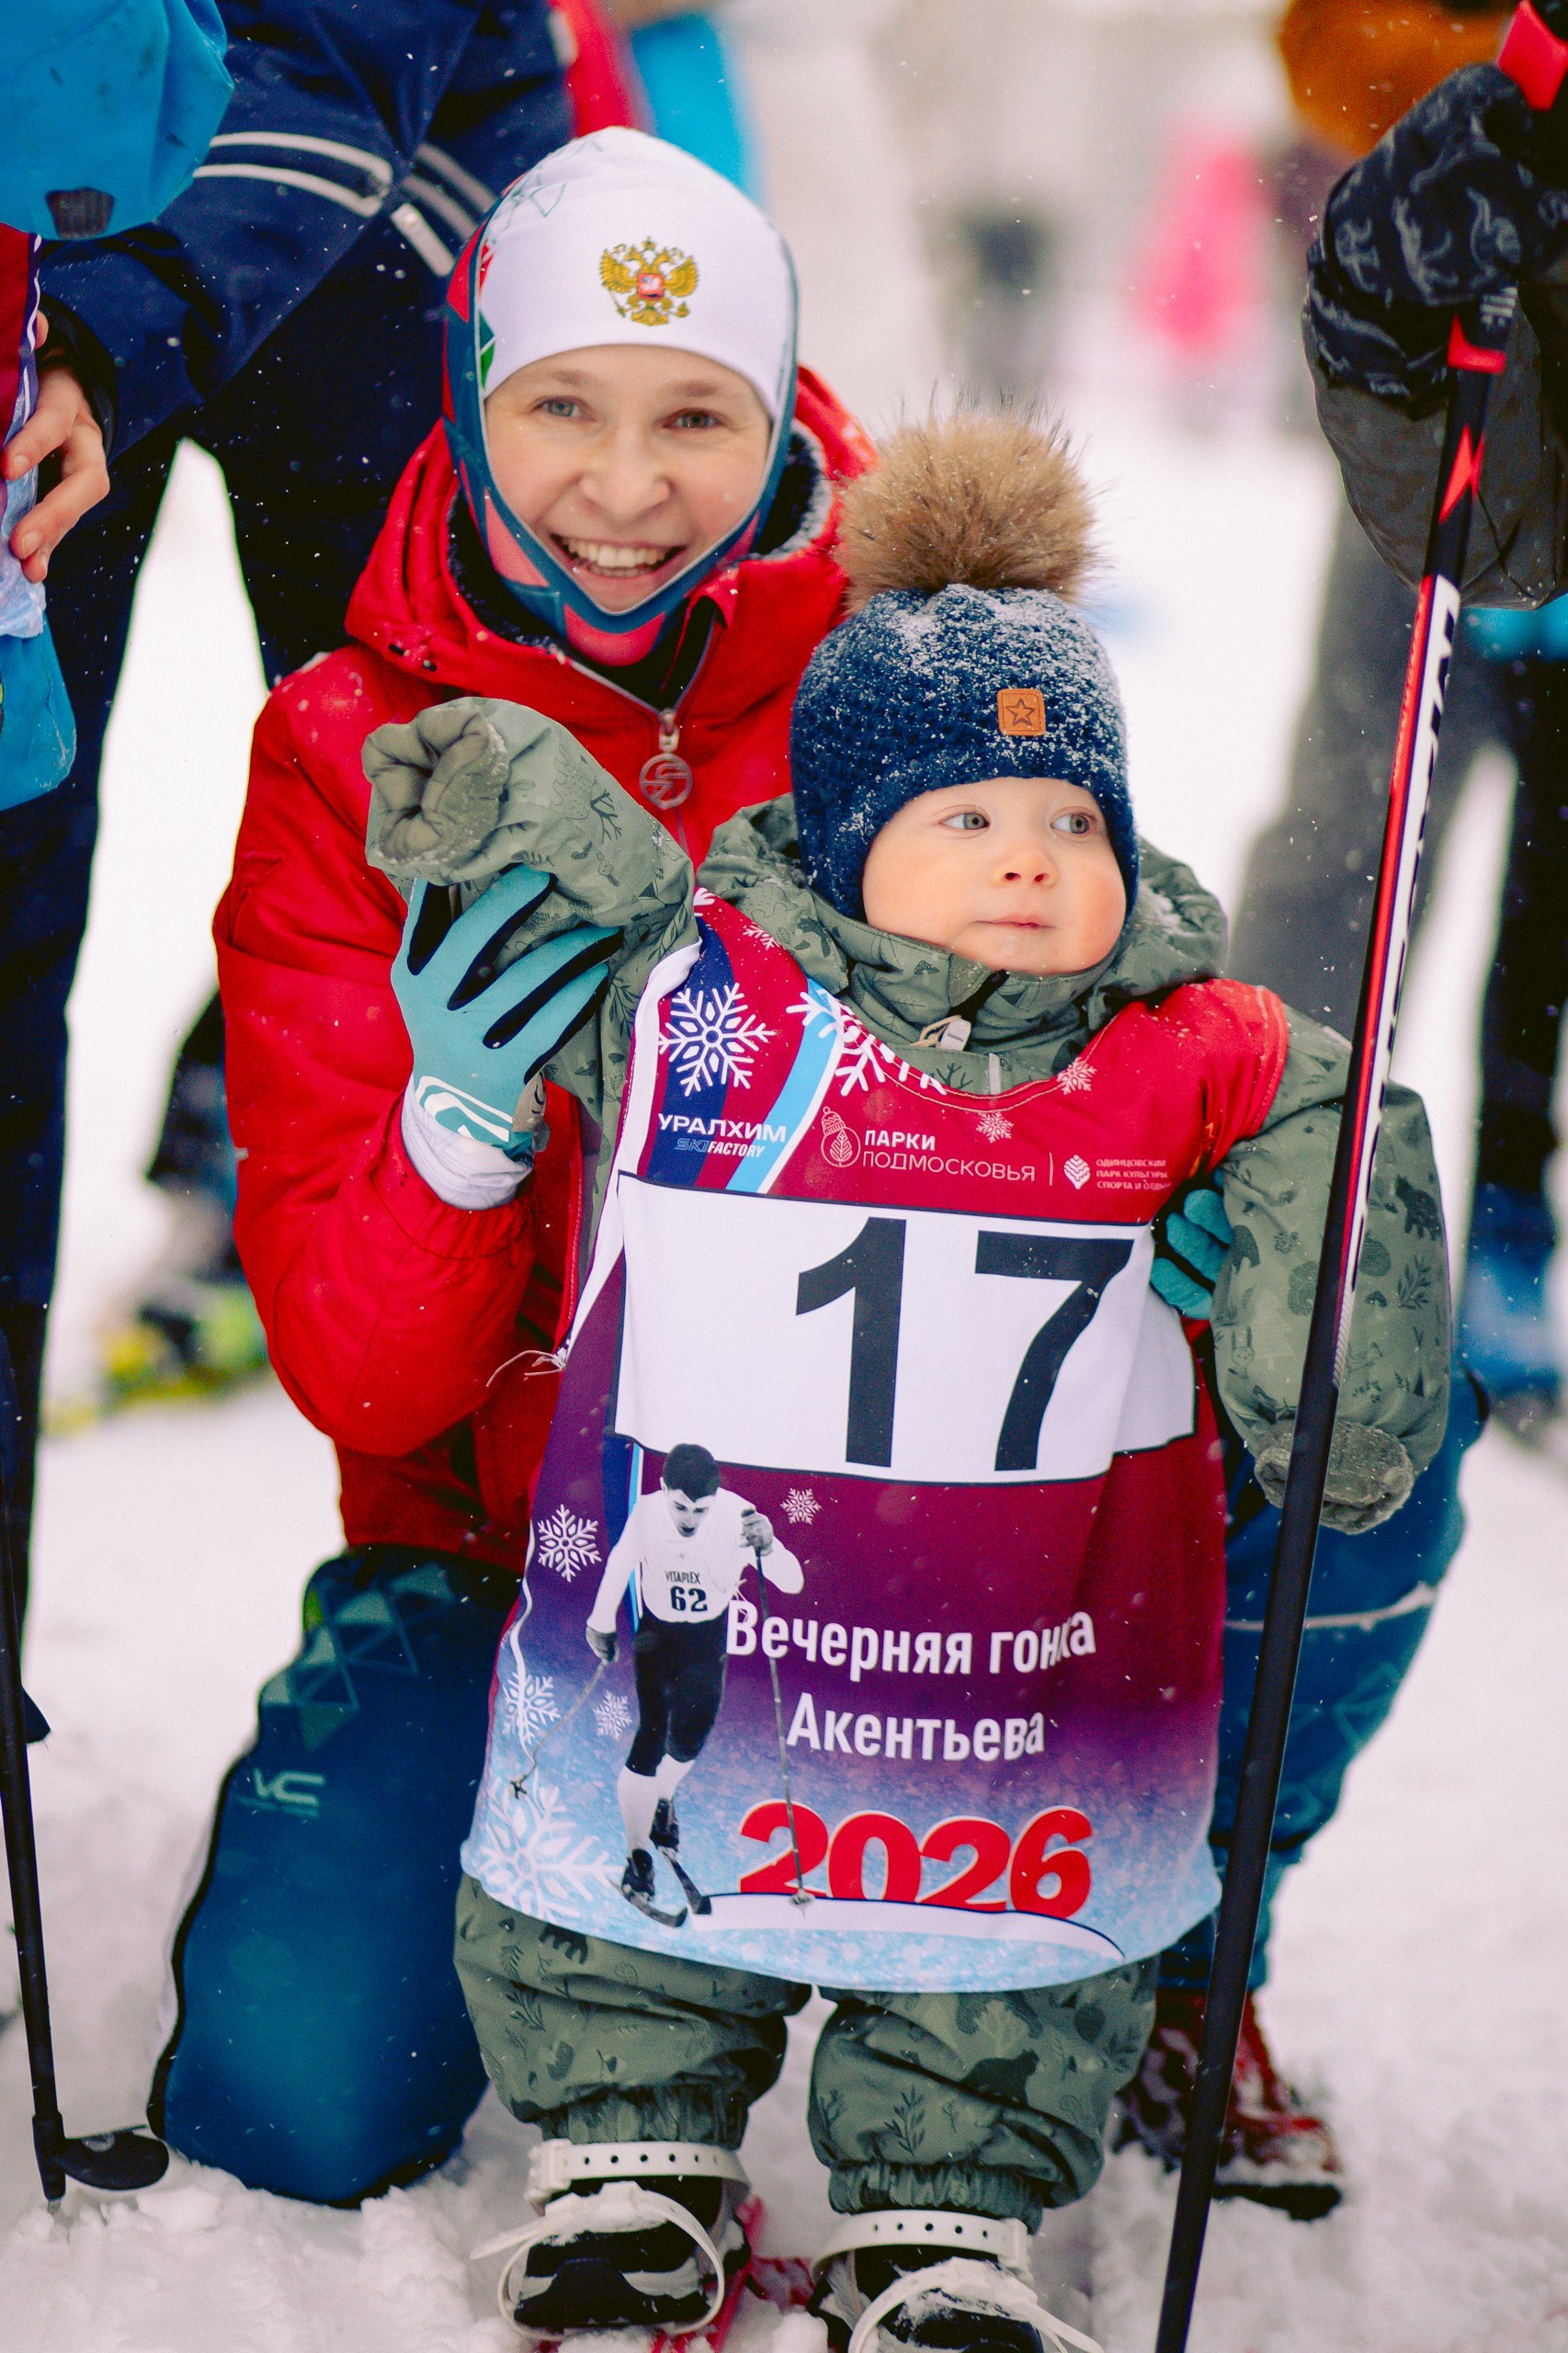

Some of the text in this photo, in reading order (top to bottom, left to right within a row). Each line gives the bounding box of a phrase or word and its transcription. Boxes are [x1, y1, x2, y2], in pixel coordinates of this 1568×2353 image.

[657, 1113, 787, 1142] УРАЛХИМ
[864, 1130, 936, 1152] ПАРКИ
[862, 1151, 1036, 1182] ПОДМОСКОВЬЯ
[1096, 1169, 1169, 1179] ПАРК КУЛЬТУРЫ
[1096, 1180, 1133, 1190] СПОРТА
[1134, 1182, 1142, 1190] И
[796, 1216, 1135, 1472] 17
[670, 1586, 709, 1612] 62
[725, 1599, 973, 1683] Вечерняя
[786, 1692, 1046, 1762] Акентьева
[739, 1799, 1094, 1920] 2026
